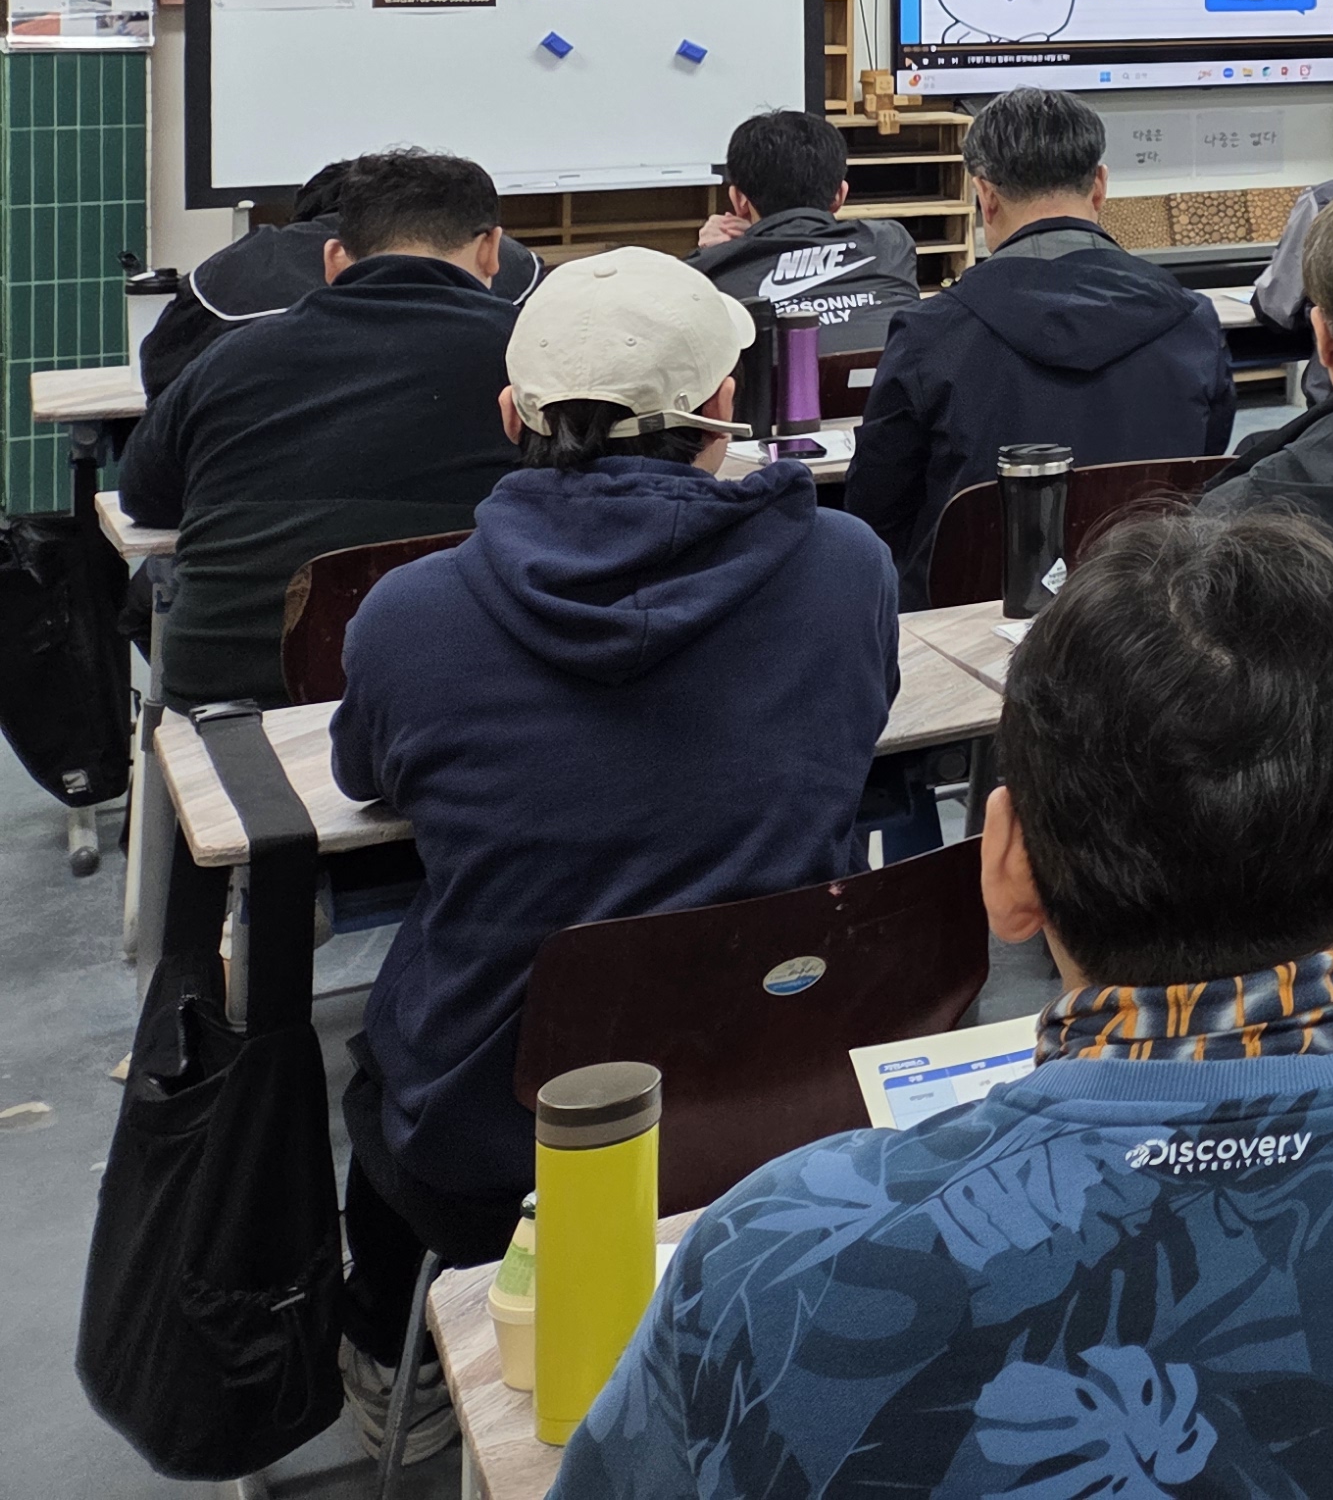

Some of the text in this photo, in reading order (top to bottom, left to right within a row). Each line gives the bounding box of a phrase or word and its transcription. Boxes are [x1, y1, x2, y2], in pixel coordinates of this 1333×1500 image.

[1132, 128, 1164, 143] 다음은
[774, 243, 847, 282] NIKE
[818, 309, 852, 326] NLY
[1145, 1131, 1312, 1166] Discovery
[1173, 1155, 1287, 1175] EXPEDITION
